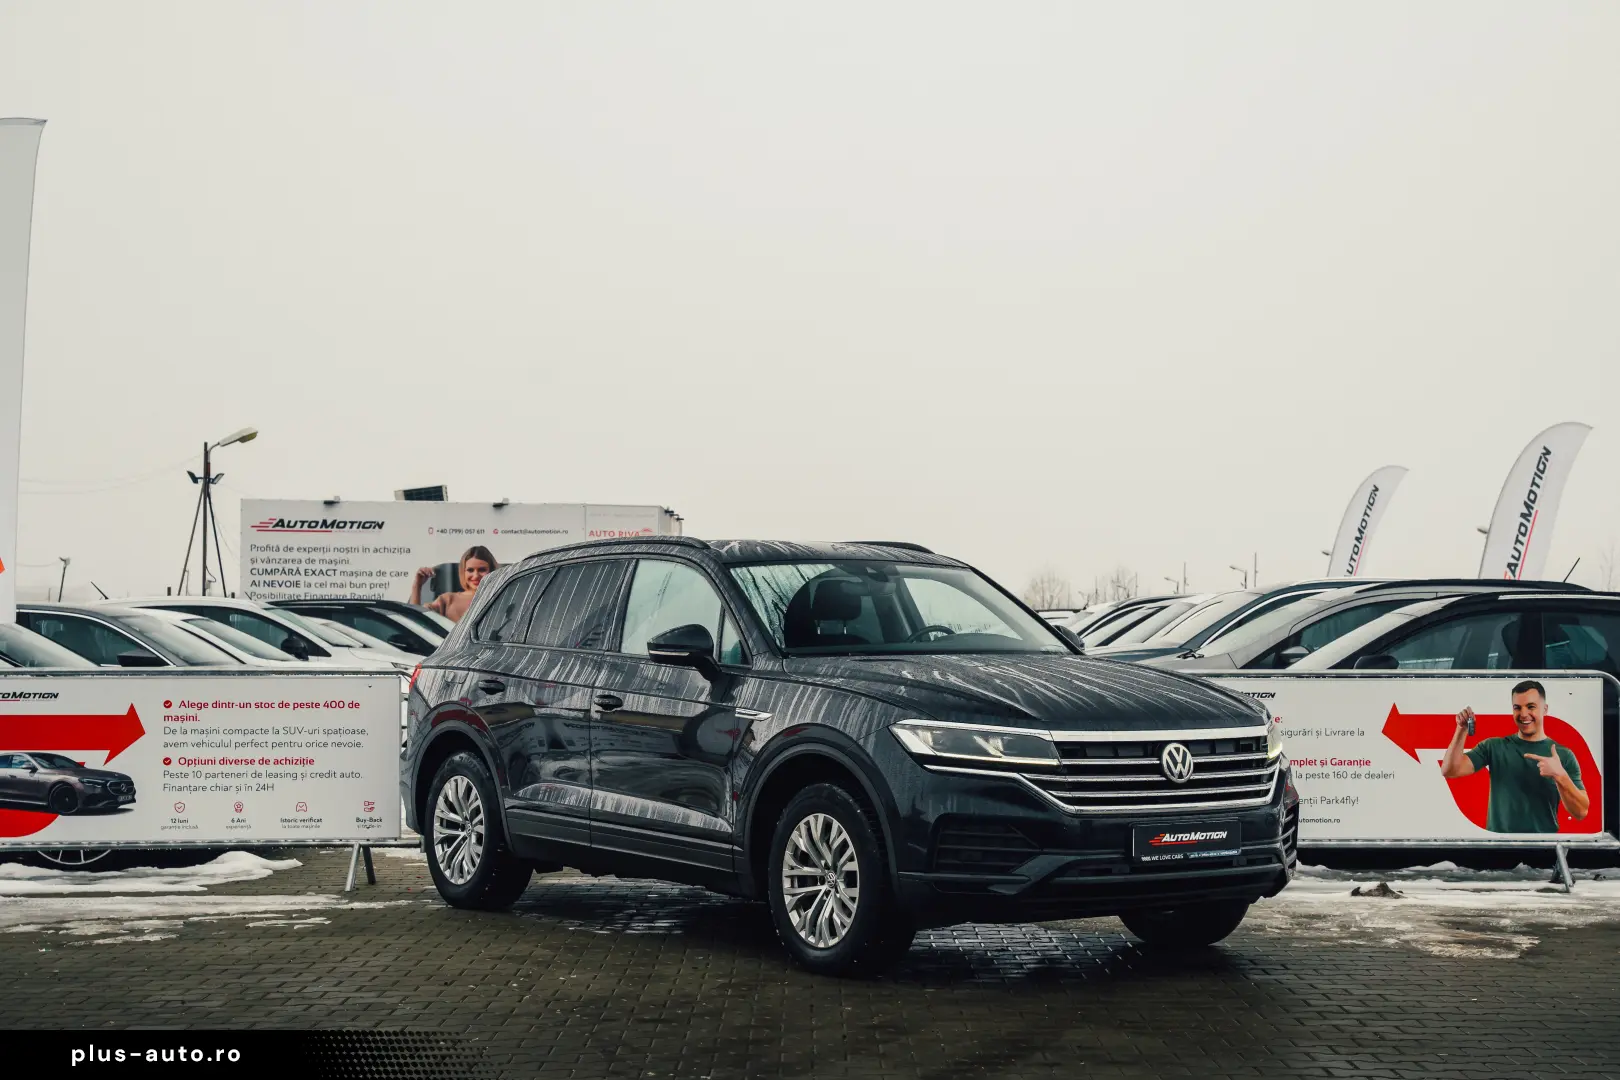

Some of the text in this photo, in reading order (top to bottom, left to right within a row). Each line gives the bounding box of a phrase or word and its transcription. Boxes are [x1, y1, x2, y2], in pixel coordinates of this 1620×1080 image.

[272, 518, 385, 529] AUTOMOTION
[1346, 484, 1380, 576] UTOMOTION
[250, 544, 280, 552] Profită
[283, 544, 294, 552] de
[305, 557, 316, 565] de
[340, 569, 373, 579] mașina
[376, 569, 387, 577] de
[263, 580, 300, 588] NEVOIE
[304, 580, 312, 588] la
[350, 580, 367, 588] bun
[0, 691, 59, 699] OMOTION
[178, 700, 360, 711] Alege dintr-un stoc de peste 400 de
[164, 713, 200, 723] mașini.
[163, 726, 178, 735] De
[180, 726, 188, 735] la
[190, 727, 220, 737] mașini
[222, 728, 270, 737] compacte
[272, 727, 280, 735] la
[282, 727, 320, 735] SUV-uri
[1280, 728, 1313, 738] sigurări
[1316, 729, 1323, 739] și
[1357, 728, 1365, 736] la
[190, 739, 232, 748] vehiculul
[234, 740, 269, 751] perfect
[271, 741, 303, 751] pentru
[305, 740, 329, 748] orice
[331, 740, 364, 748] nevoie.
[178, 757, 315, 768] Opțiuni diverse de achiziție
[1290, 757, 1371, 768] mplet și Garanție
[163, 770, 190, 779] Peste
[192, 771, 202, 779] 10
[205, 771, 248, 781] parteneri
[250, 770, 263, 779] de
[265, 770, 298, 781] leasing
[300, 771, 307, 781] și
[309, 770, 337, 779] credit
[1295, 770, 1395, 781] la peste 160 de dealeri
[163, 783, 207, 794] Finanțare
[209, 783, 231, 792] chiar
[235, 784, 242, 794] și
[255, 783, 275, 792] 24H
[1299, 796, 1359, 808] enții Park4fly!
[1161, 831, 1228, 842] AUTOMOTION
